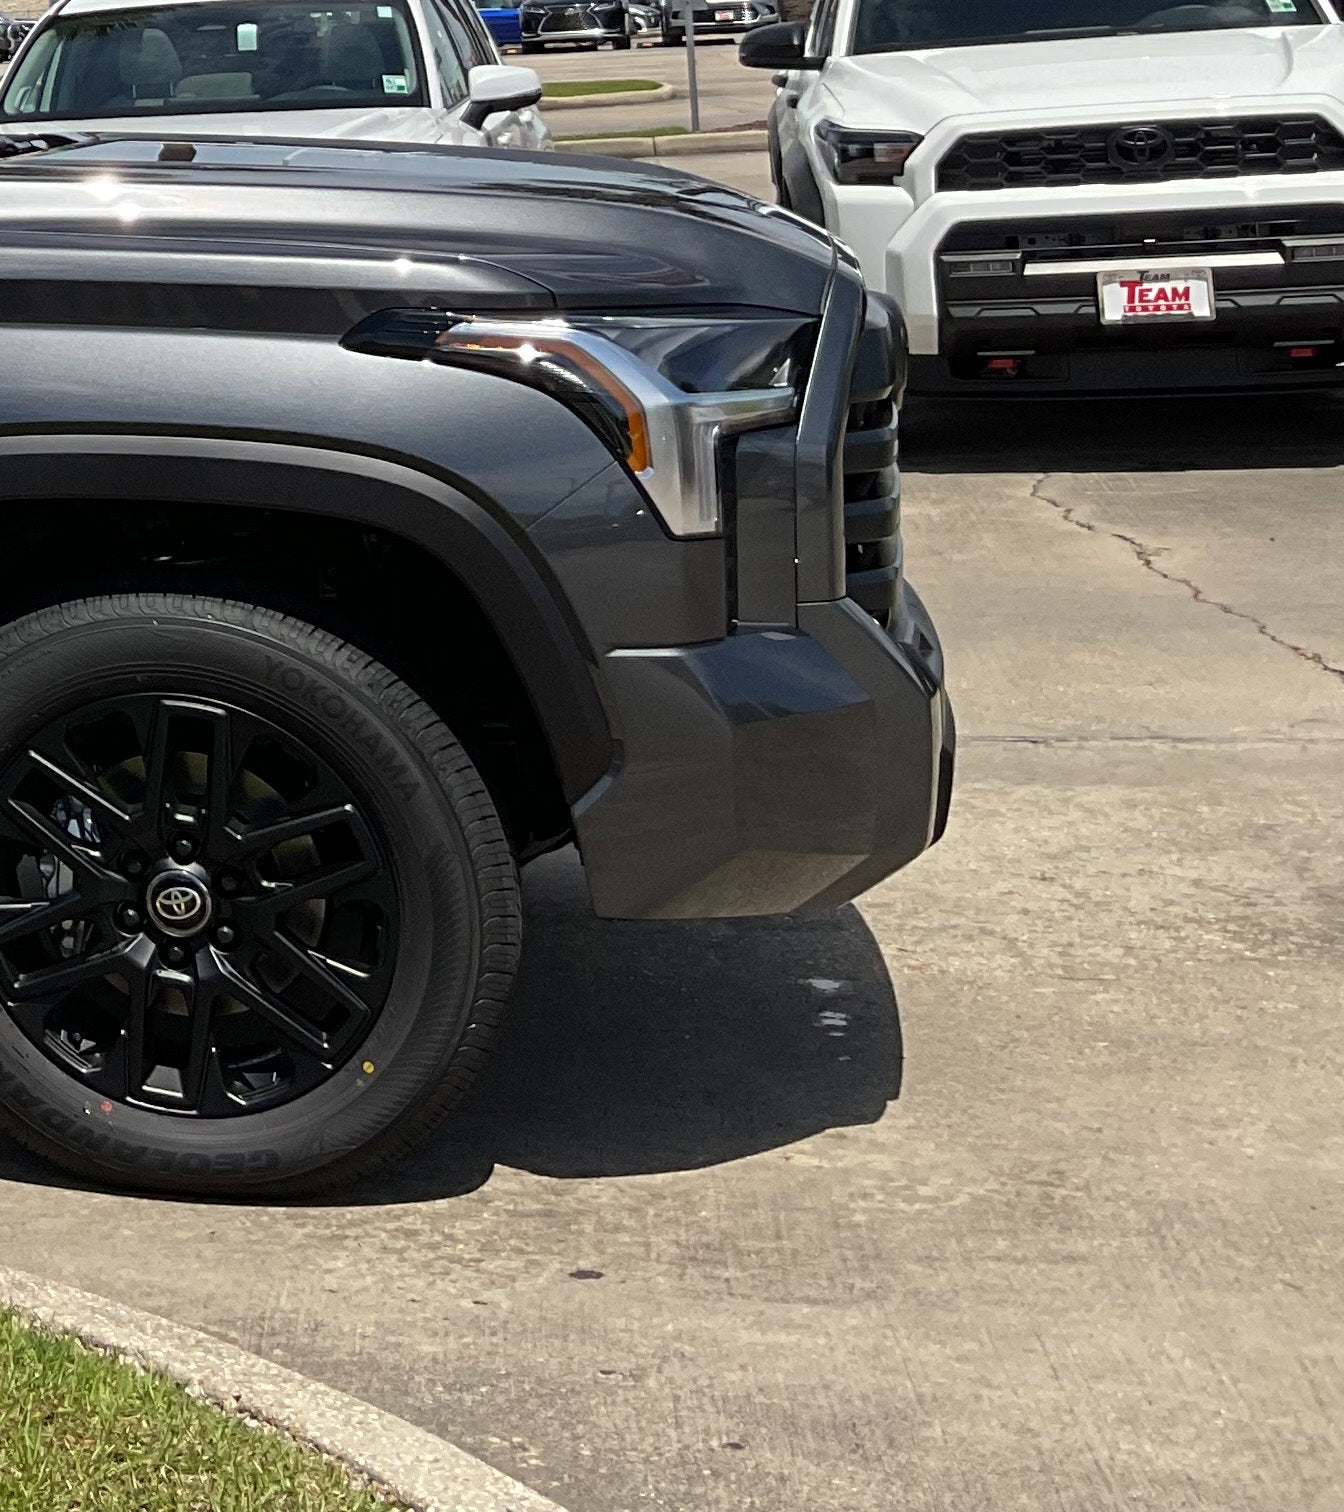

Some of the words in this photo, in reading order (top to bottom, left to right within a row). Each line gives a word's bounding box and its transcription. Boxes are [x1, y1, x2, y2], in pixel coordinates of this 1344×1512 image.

[1137, 270, 1171, 281] TEAM
[1119, 280, 1191, 304] TEAM
[1124, 303, 1190, 313] TOYOTA
[263, 653, 421, 804] YOKOHAMA
